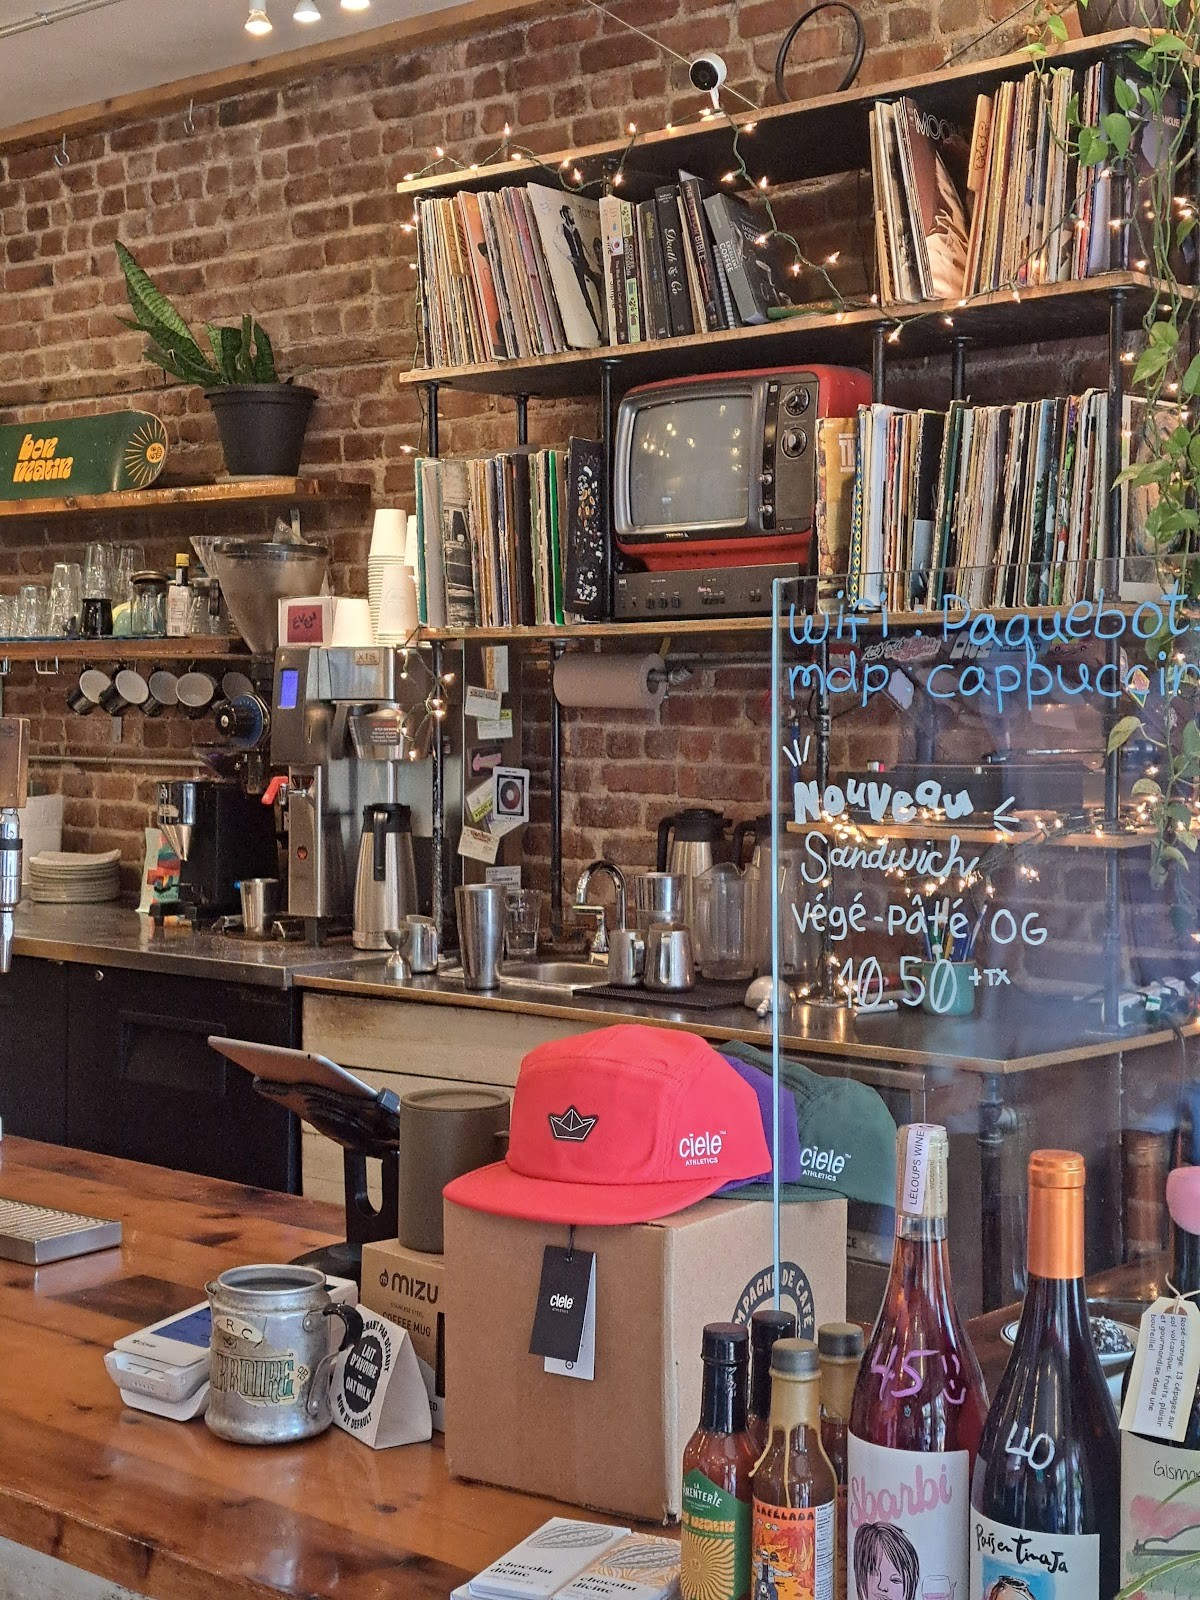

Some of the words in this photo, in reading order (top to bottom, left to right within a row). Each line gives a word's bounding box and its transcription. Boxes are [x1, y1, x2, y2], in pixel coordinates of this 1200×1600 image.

[664, 228, 678, 263] Death
[694, 235, 707, 261] BIBLE
[719, 242, 735, 274] COFFEE
[668, 266, 679, 278] &
[670, 280, 683, 296] Co
[18, 433, 59, 460] bon
[13, 457, 74, 482] matin
[788, 650, 890, 707] mdp
[801, 830, 980, 884] Sandwich
[991, 910, 1048, 946] OG
[685, 1157, 719, 1167] ATHLETICS
[802, 1169, 837, 1182] ATHLETICS
[782, 1268, 796, 1288] DE
[413, 1323, 432, 1338] MUG
[361, 1343, 377, 1362] LAIT
[1155, 1326, 1166, 1375] gourmandise
[349, 1353, 379, 1379] D'AVOINE
[871, 1343, 939, 1401] 45
[345, 1376, 357, 1394] OAT
[350, 1411, 373, 1430] DEFAULT
[1005, 1420, 1056, 1471] 40
[498, 1561, 553, 1575] chocolat
[580, 1576, 638, 1592] chocolat
